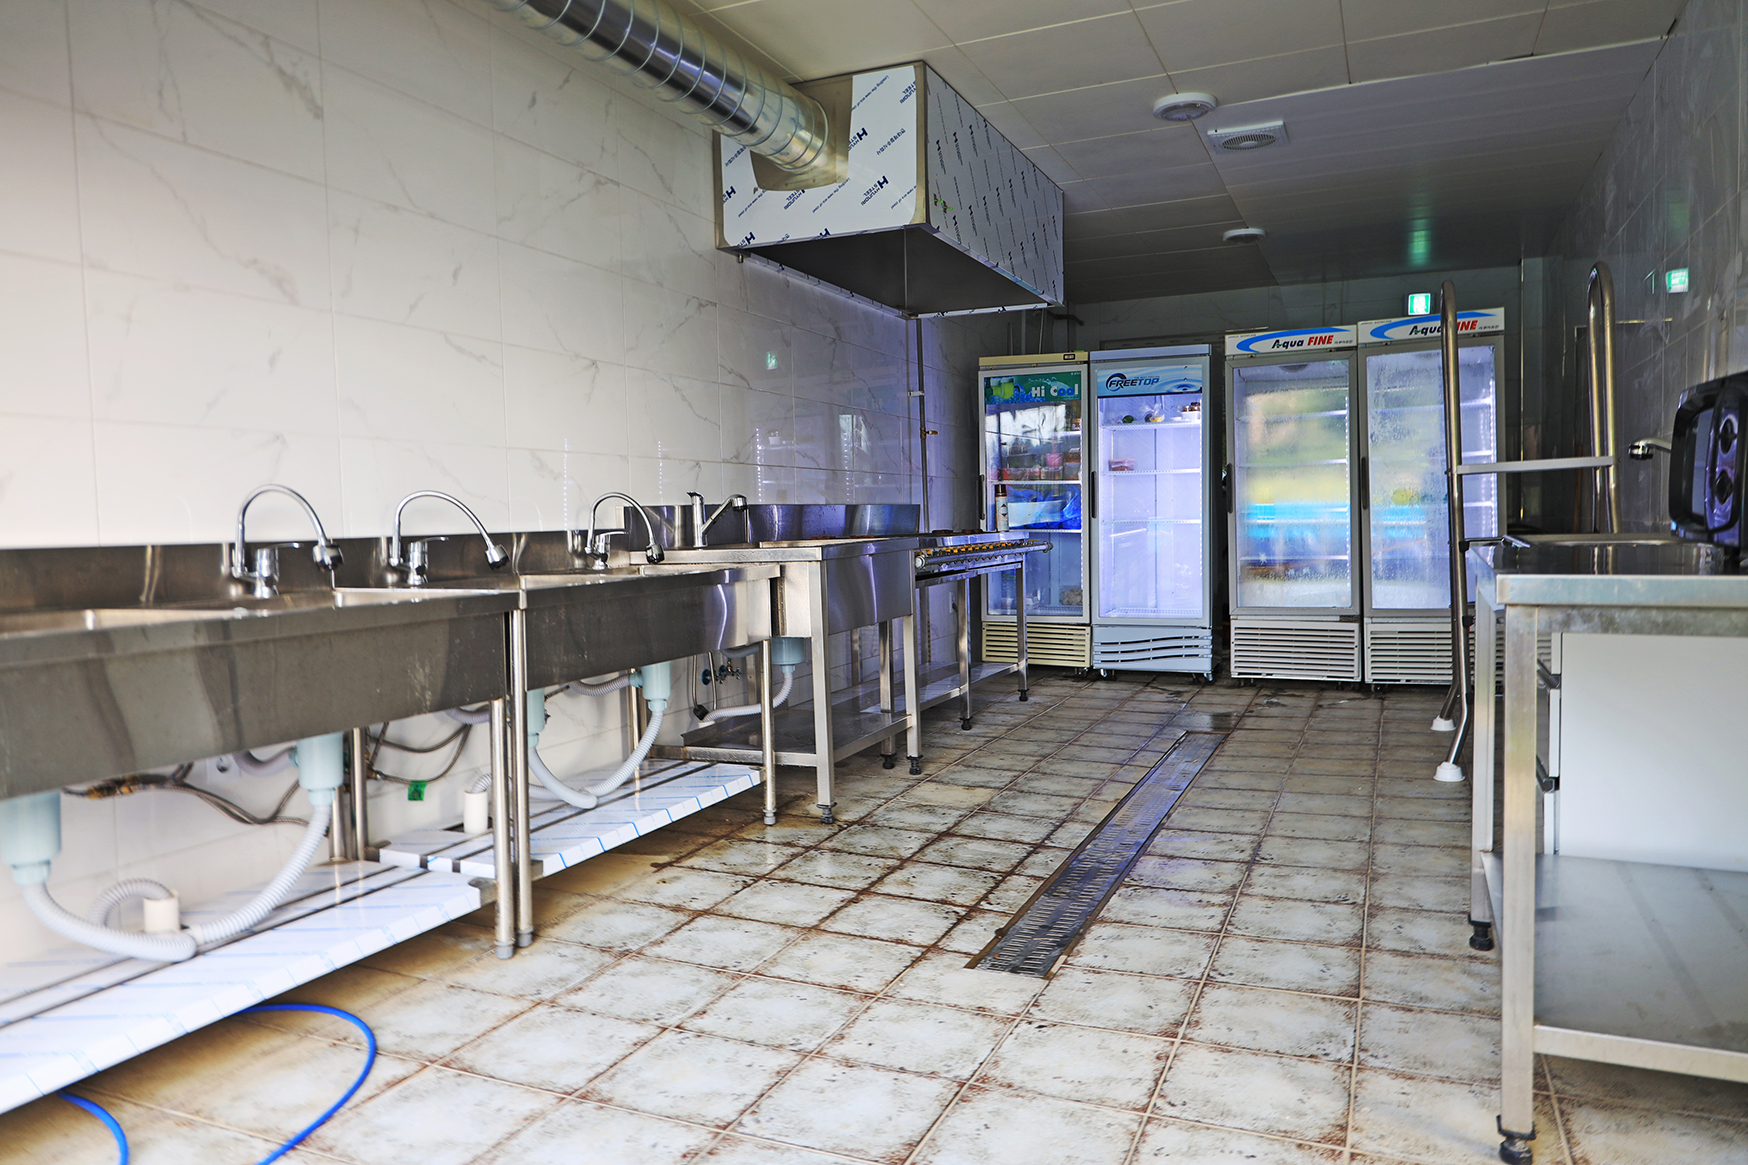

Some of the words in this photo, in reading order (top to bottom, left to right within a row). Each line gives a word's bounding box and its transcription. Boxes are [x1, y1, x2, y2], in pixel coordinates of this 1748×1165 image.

[861, 187, 880, 205] HYUNDAI
[863, 183, 878, 196] STEEL
[1457, 320, 1478, 331] INE
[1272, 339, 1304, 349] Aqua
[1307, 335, 1334, 346] FINE
[1109, 378, 1160, 388] FREETOP
[1031, 386, 1045, 397] Hi
[1050, 384, 1079, 397] Cool
